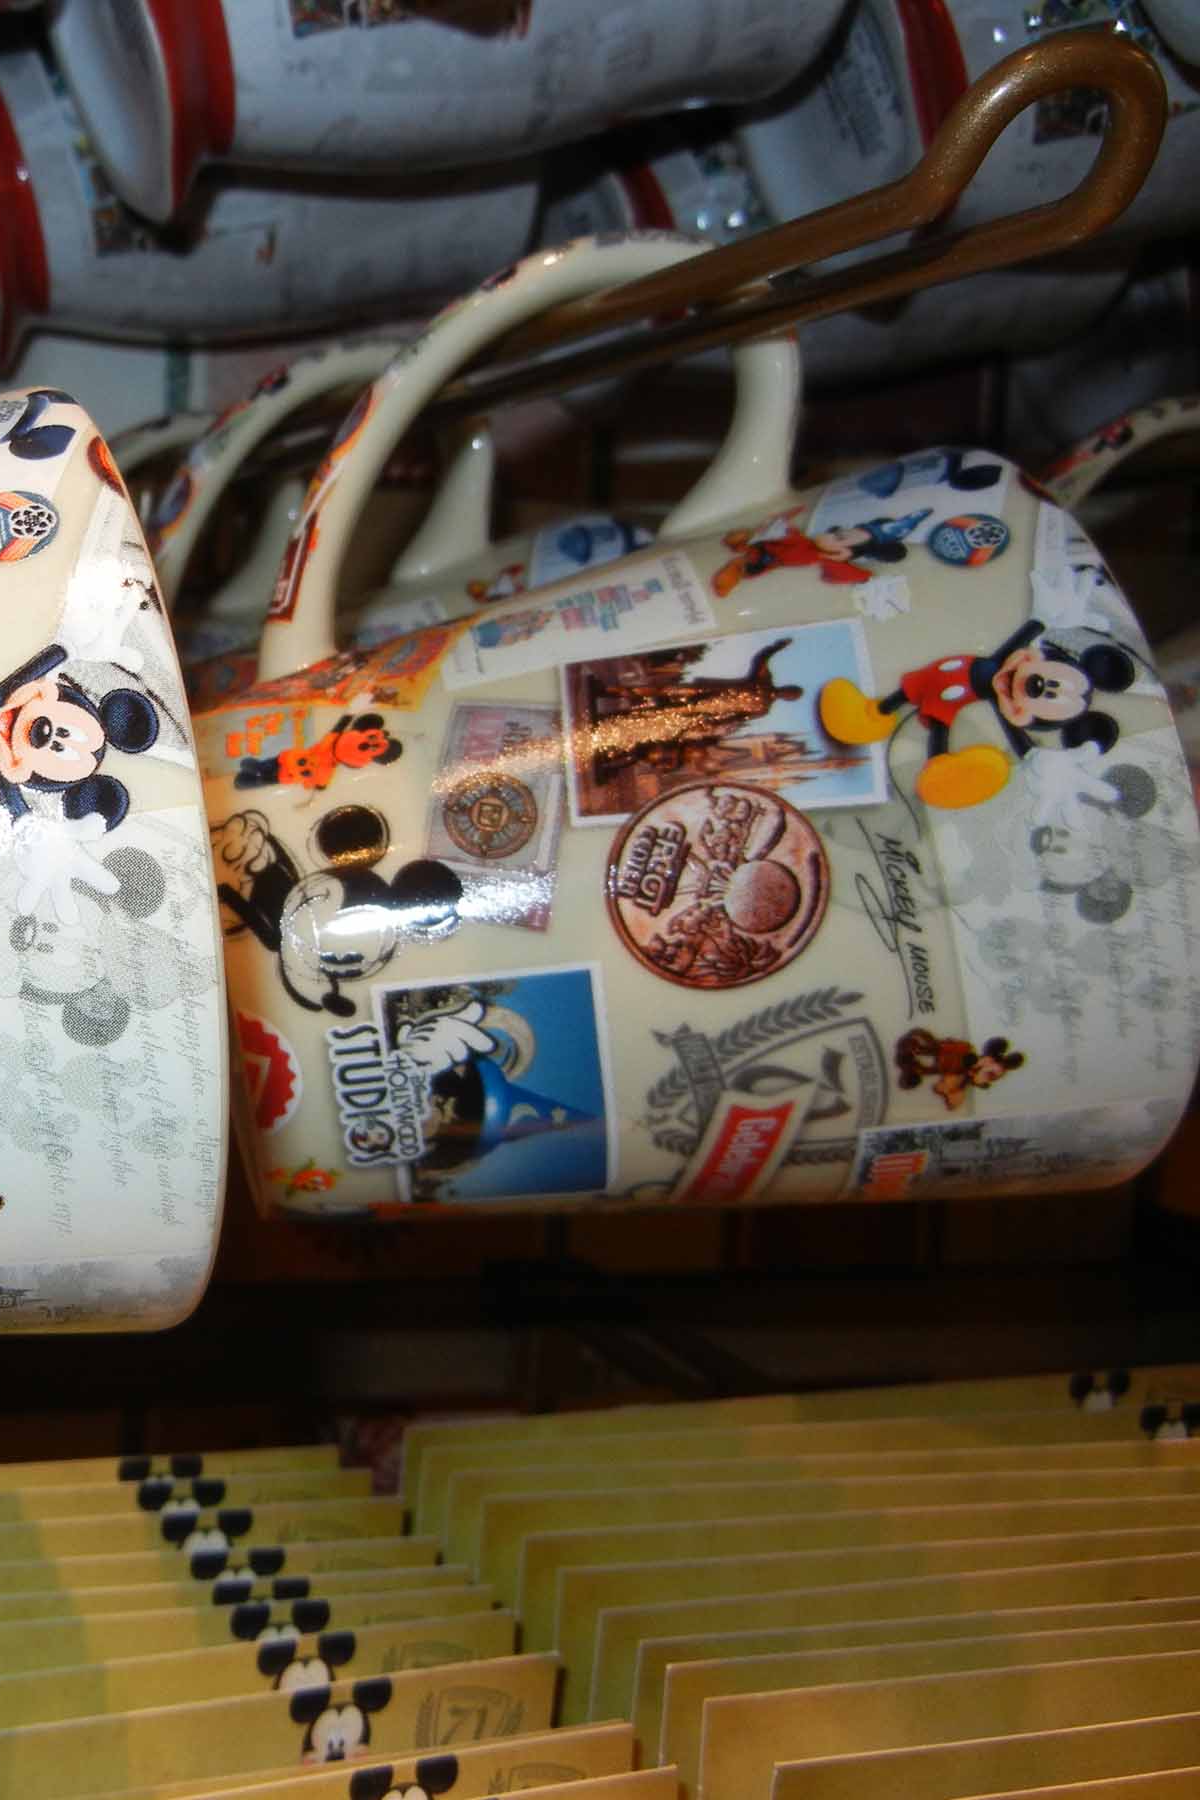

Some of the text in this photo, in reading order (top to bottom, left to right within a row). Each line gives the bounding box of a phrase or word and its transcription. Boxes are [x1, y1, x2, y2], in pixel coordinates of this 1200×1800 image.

[906, 942, 936, 1015] MOUSE
[331, 1025, 398, 1163] STUDIOS
[384, 1055, 420, 1157] HOLLYWOOD
